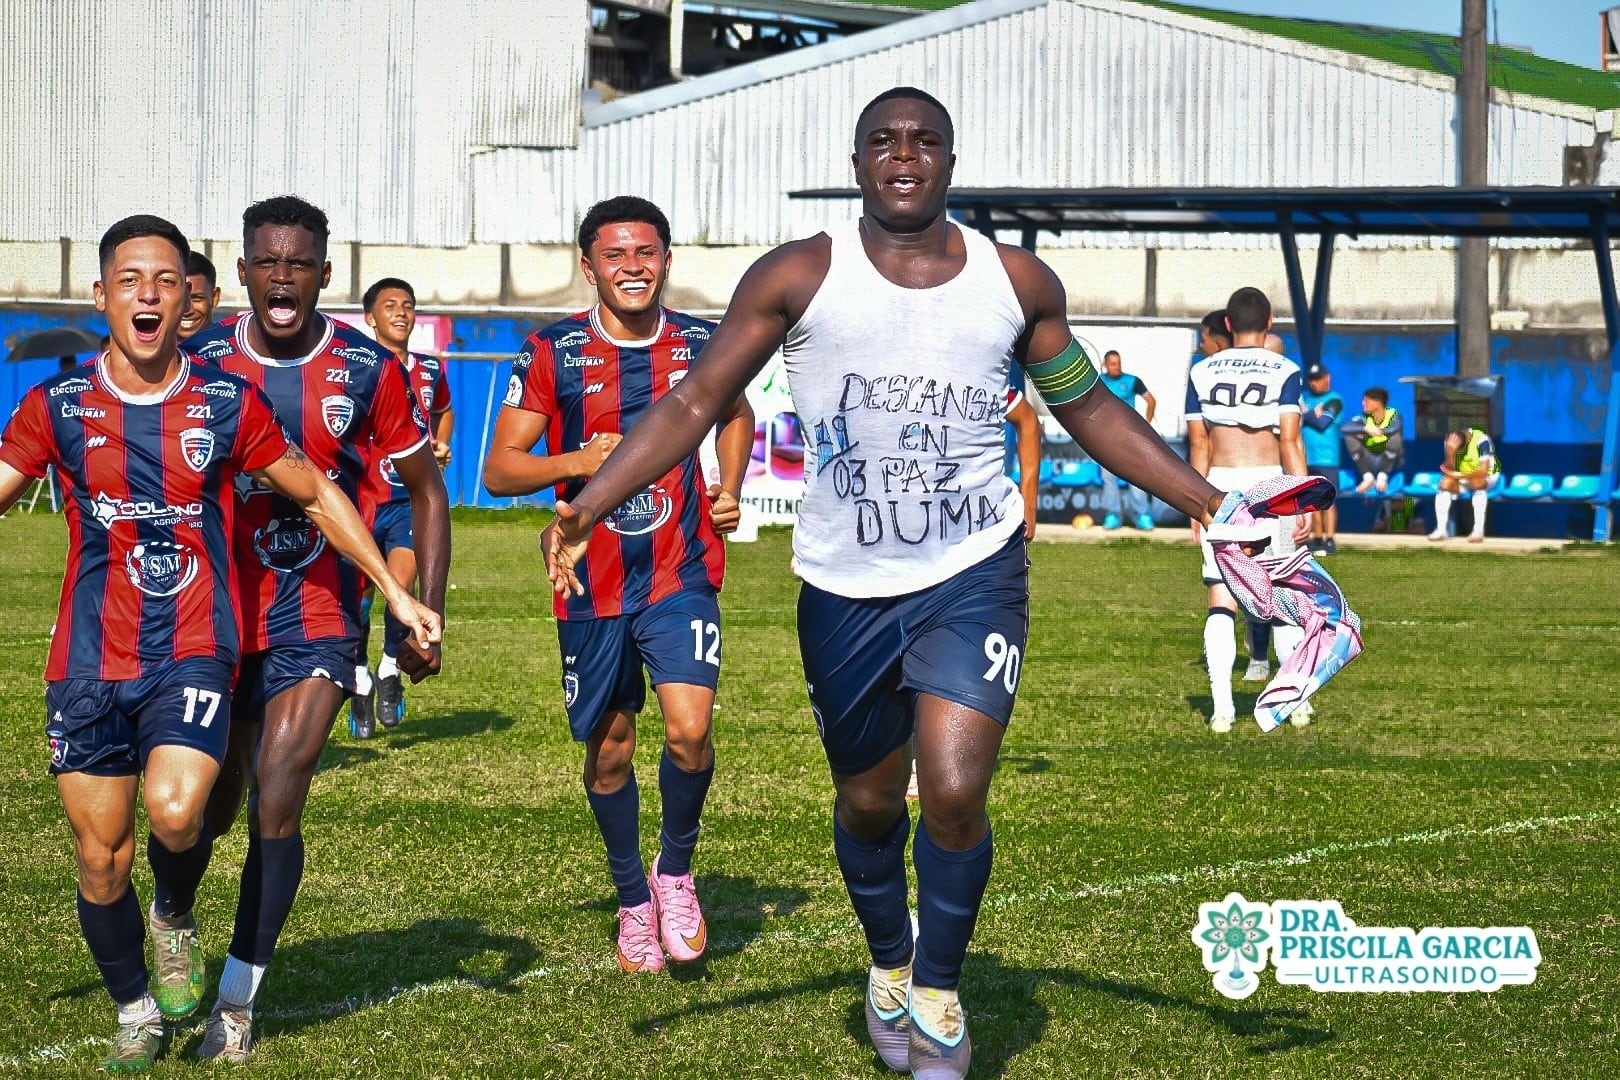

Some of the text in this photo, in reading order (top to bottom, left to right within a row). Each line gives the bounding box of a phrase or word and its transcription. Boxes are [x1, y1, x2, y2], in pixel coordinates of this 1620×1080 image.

[331, 347, 378, 367] Electrolit
[670, 347, 695, 361] 221.
[49, 384, 95, 397] Electrolit
[190, 385, 237, 399] Electrolit
[324, 367, 354, 384] 221.
[185, 404, 215, 419] 221.
[838, 373, 1002, 422] DESCANSA
[898, 421, 951, 457] EN
[879, 456, 961, 494] PAZ
[853, 493, 1005, 546] DUMA
[689, 619, 721, 667] 12
[982, 632, 1021, 695] 90
[183, 686, 222, 729] 17
